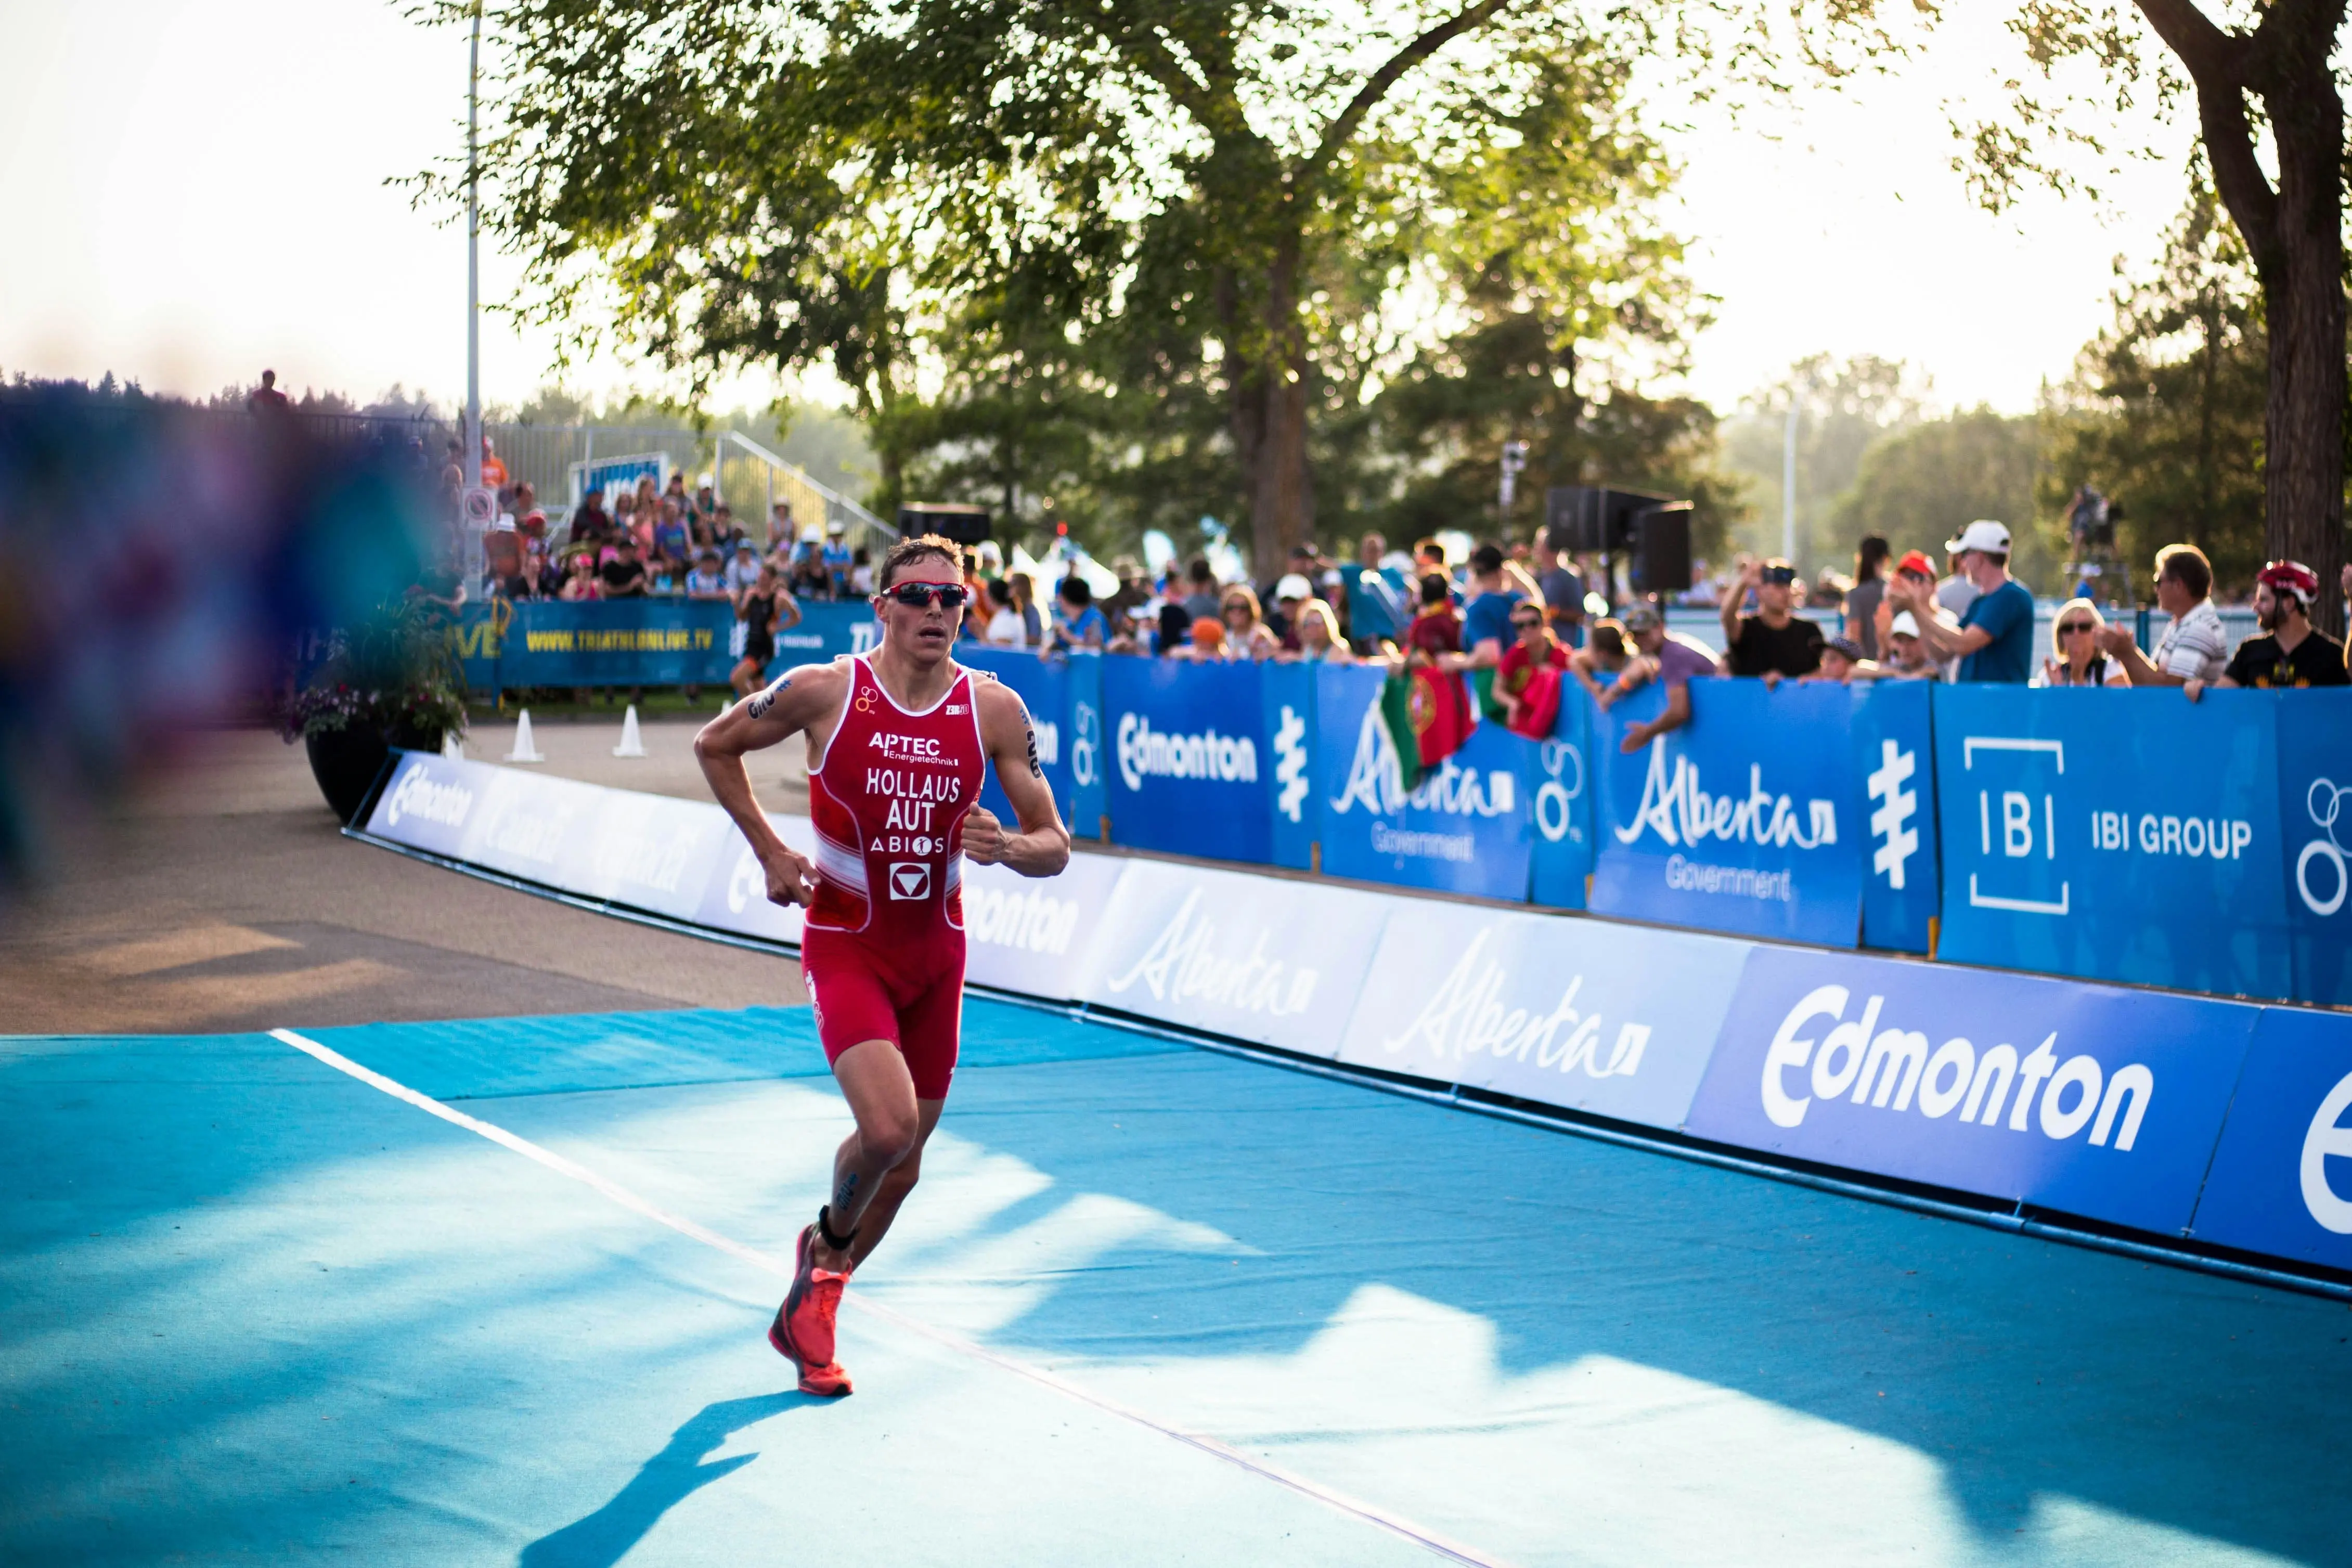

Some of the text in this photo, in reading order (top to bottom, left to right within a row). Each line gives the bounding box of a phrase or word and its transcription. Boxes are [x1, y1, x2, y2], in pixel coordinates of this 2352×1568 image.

[526, 628, 713, 652] WWW.TRIATHLONLIVE.TV
[869, 732, 940, 756] APTEC
[889, 750, 953, 766] Energietechnik
[1117, 711, 1258, 792] Edmonton
[866, 768, 961, 803] HOLLAUS
[1615, 734, 1827, 849] Alberta
[885, 799, 936, 832] AUT
[1980, 789, 2055, 860] IBI
[2092, 811, 2252, 859] IBI GROUP
[870, 836, 944, 856] ABIOS
[1371, 821, 1475, 863] Government
[1665, 853, 1791, 902] Government
[1107, 886, 1296, 1016] Alberta
[1384, 927, 1618, 1079] Alberta
[1761, 984, 2154, 1152] Edmonton
